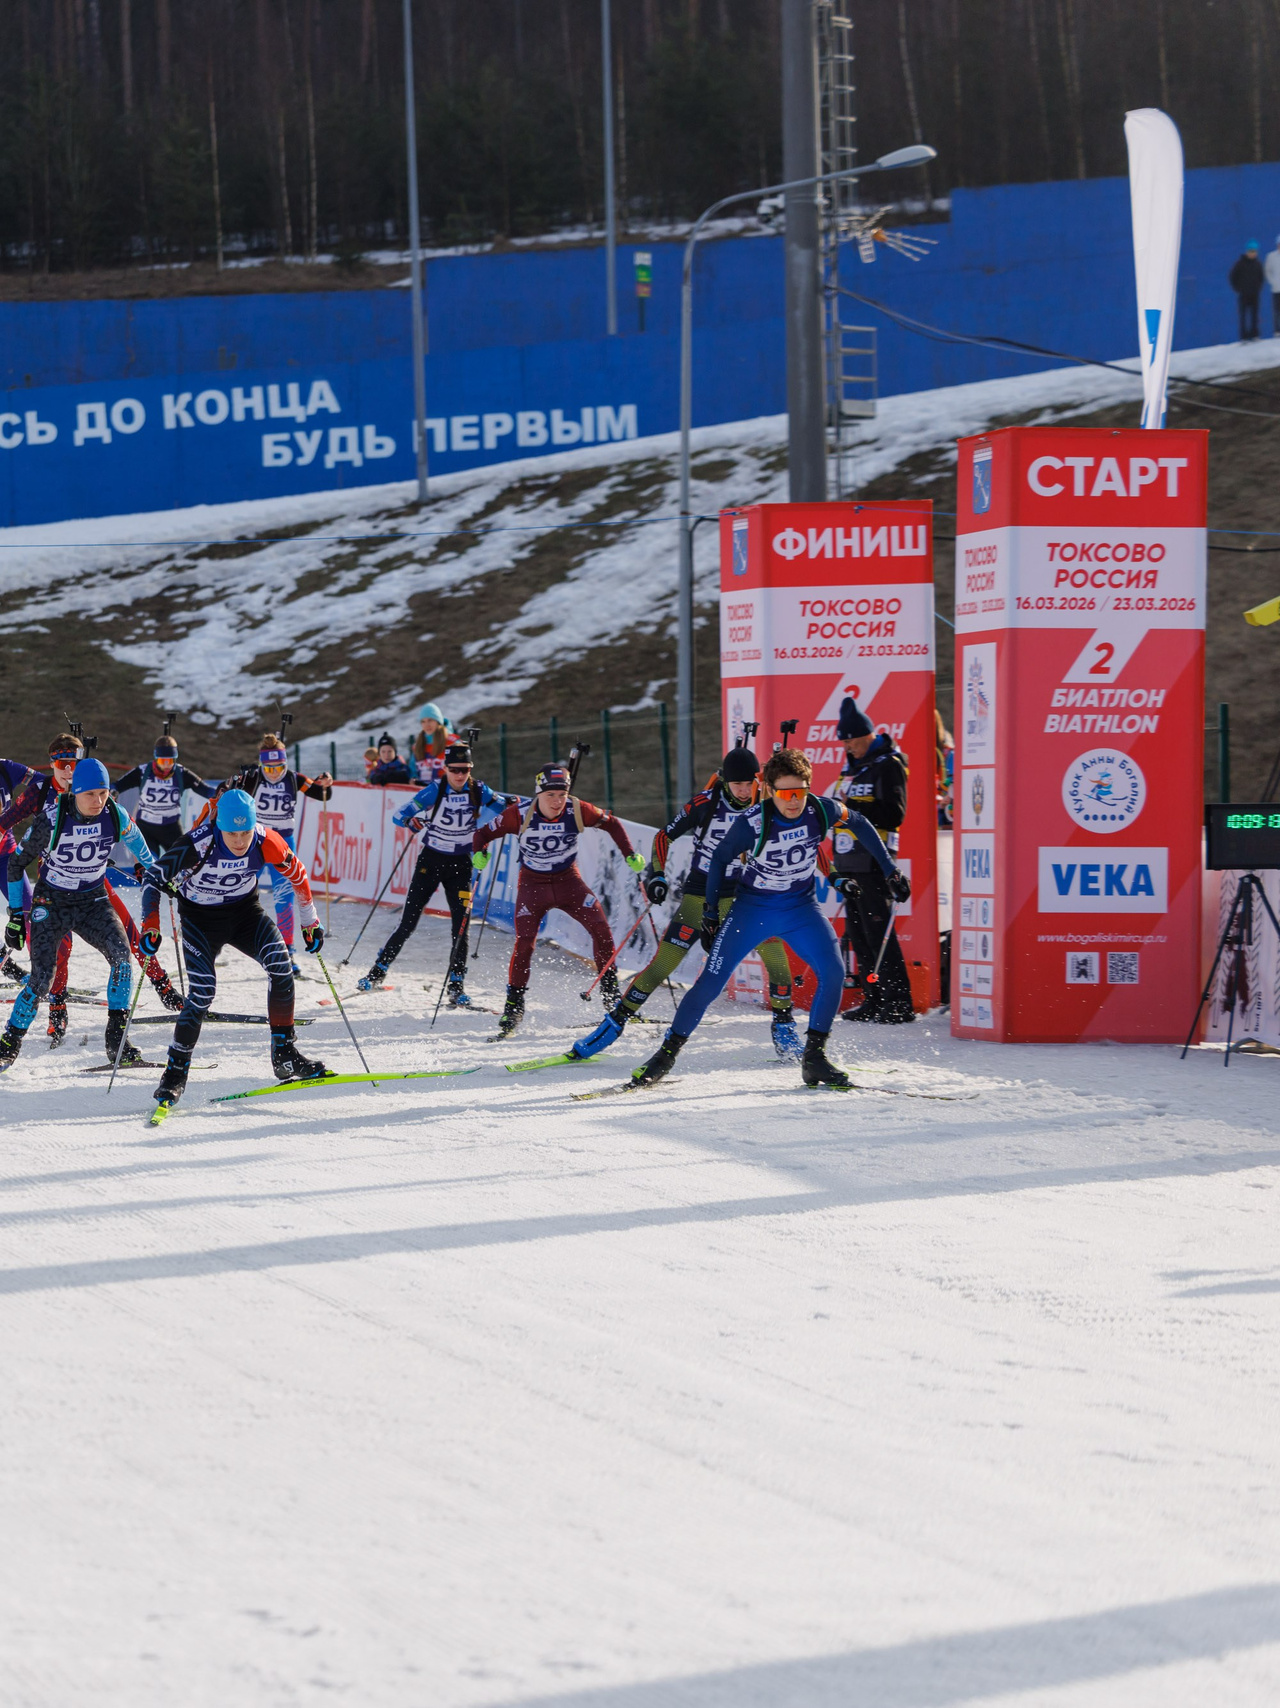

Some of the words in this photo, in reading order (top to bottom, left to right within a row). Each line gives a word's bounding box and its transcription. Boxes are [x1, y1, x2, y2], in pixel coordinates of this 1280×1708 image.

[73, 398, 146, 447] ДО
[162, 379, 341, 430] КОНЦА
[261, 424, 396, 470] БУДЬ
[412, 403, 638, 454] ПЕРВЫМ
[1027, 456, 1188, 498] СТАРТ
[772, 525, 927, 560] ФИНИШ
[1047, 542, 1166, 563] ТОКСОВО
[1054, 569, 1158, 589] РОССИЯ
[799, 597, 902, 617] ТОКСОВО
[1016, 597, 1096, 611] 16.03.2026
[1113, 597, 1196, 611] 23.03.2026
[806, 621, 896, 640] РОССИЯ
[773, 646, 843, 659] 16.03.2026
[858, 643, 930, 657] 23.03.2026
[1089, 642, 1115, 675] 2
[1050, 688, 1166, 708] БИАТЛОН
[807, 722, 906, 742] БИОН
[1043, 714, 1160, 734] BIATHLON
[1069, 773, 1085, 814] Кубок
[1081, 755, 1115, 772] Анны
[146, 787, 180, 804] 520
[257, 792, 293, 811] 518
[440, 806, 474, 828] 512
[76, 826, 99, 836] VEKA
[782, 828, 805, 841] VEKA
[56, 836, 114, 864] 505
[221, 860, 245, 869] VEKA
[964, 848, 991, 879] VEKA
[1051, 863, 1155, 896] VEKA
